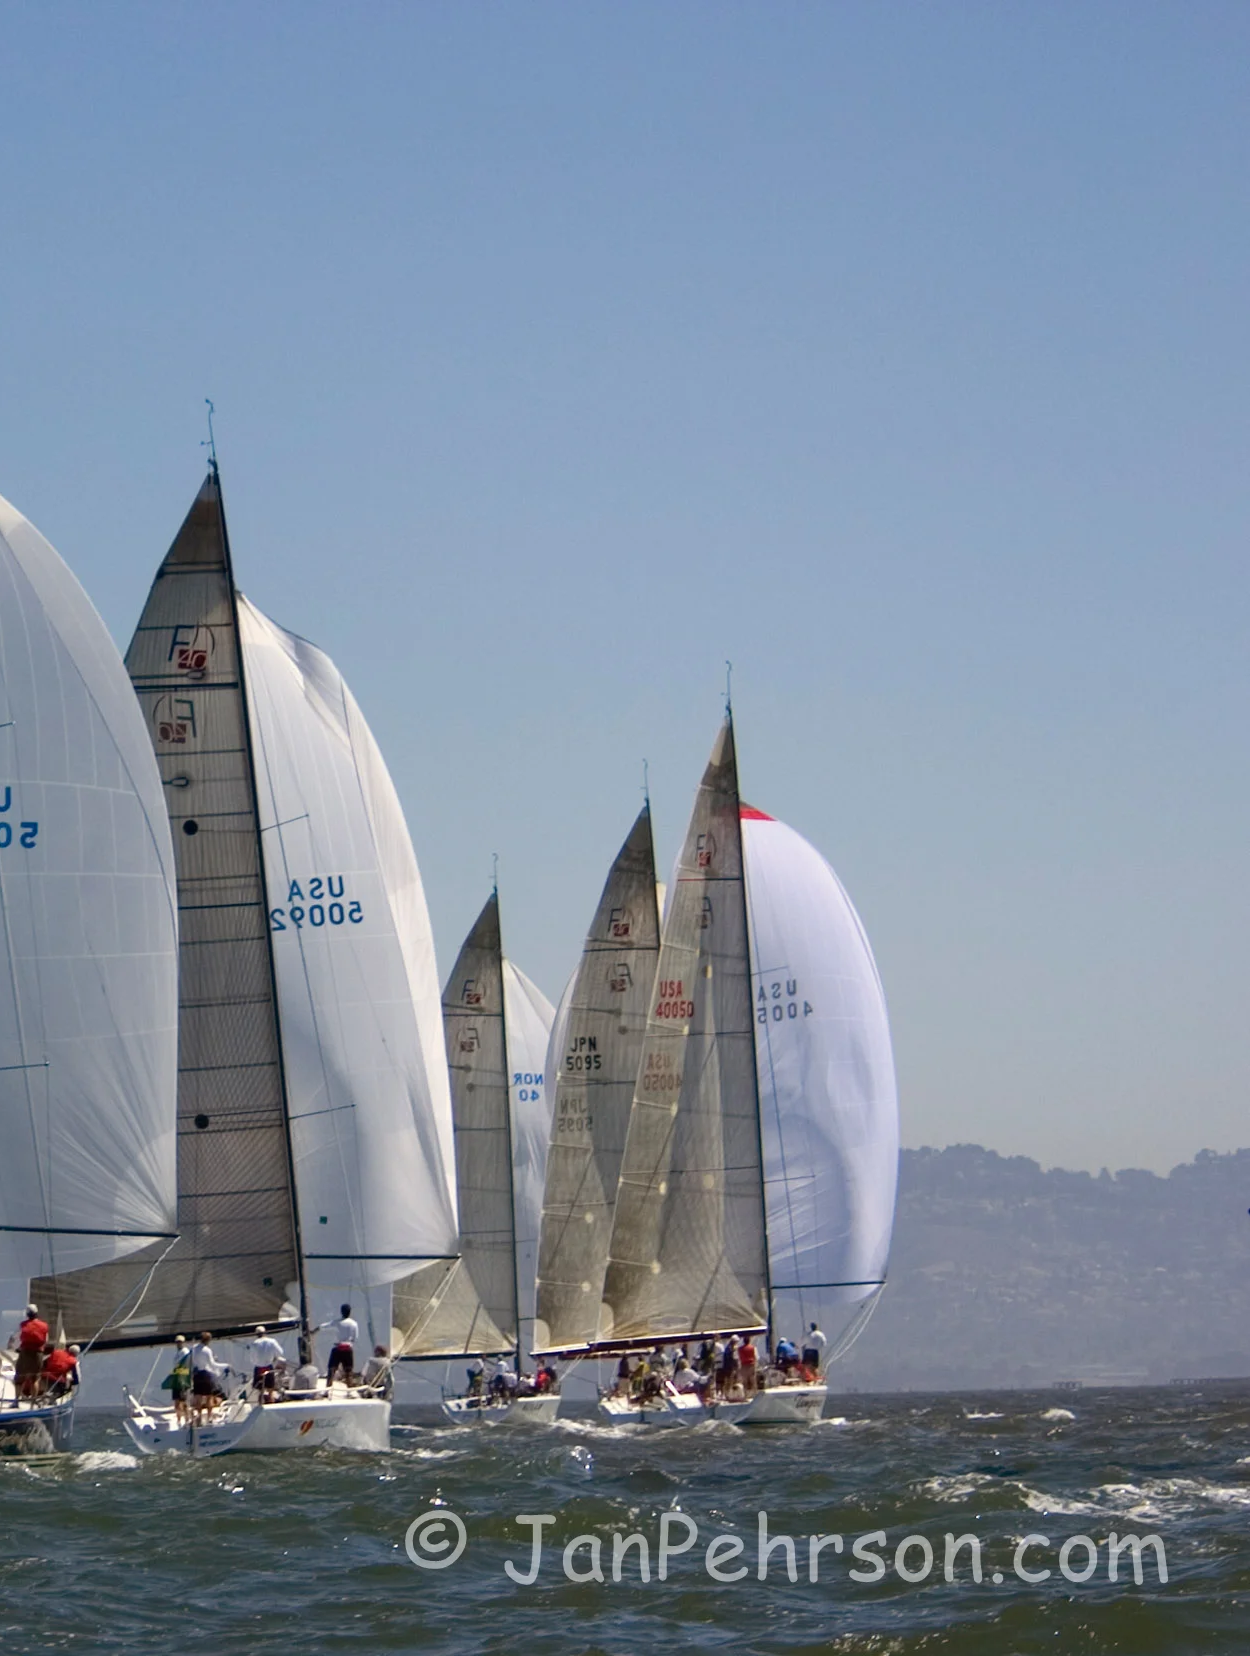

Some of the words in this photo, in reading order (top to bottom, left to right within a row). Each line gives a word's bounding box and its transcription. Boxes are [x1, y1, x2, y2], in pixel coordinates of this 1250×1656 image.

[659, 981, 683, 998] USA
[655, 1000, 695, 1019] 40050
[570, 1036, 597, 1053] JPN
[566, 1055, 602, 1071] 5095
